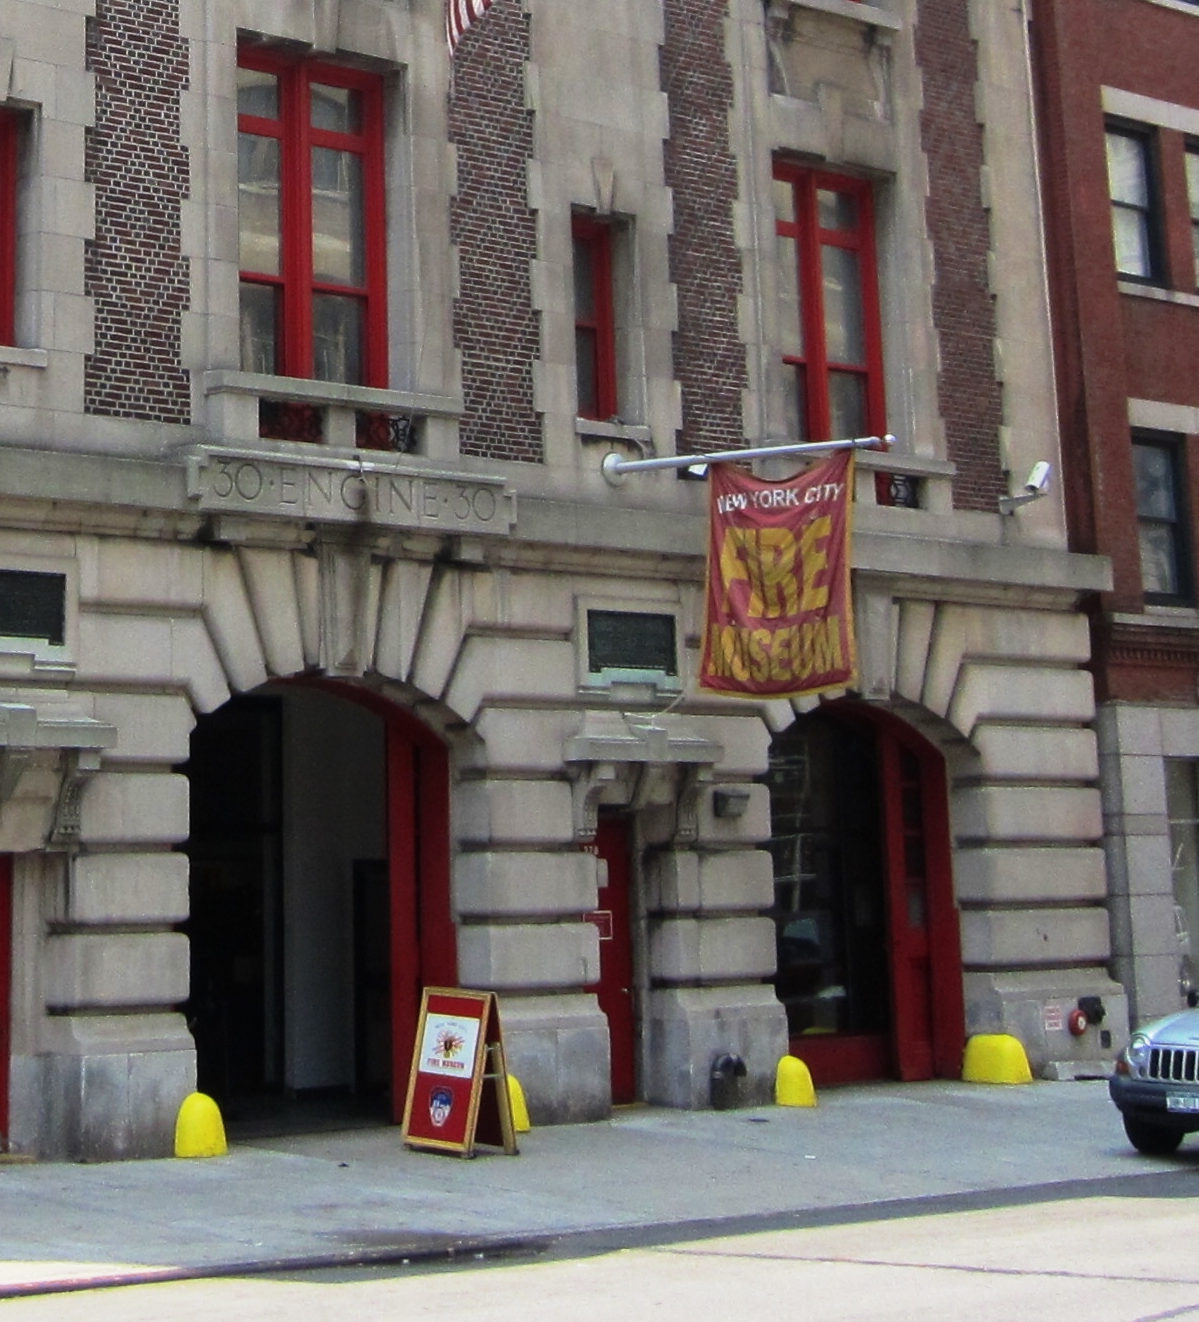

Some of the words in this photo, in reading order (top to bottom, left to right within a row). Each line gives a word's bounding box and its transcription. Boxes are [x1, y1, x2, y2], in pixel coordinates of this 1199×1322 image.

[279, 467, 439, 520] ENGINE
[716, 493, 748, 514] NEW
[752, 488, 800, 509] YORK
[804, 482, 845, 505] CITY
[720, 515, 832, 618] FIRE
[707, 614, 844, 682] MUSEUM
